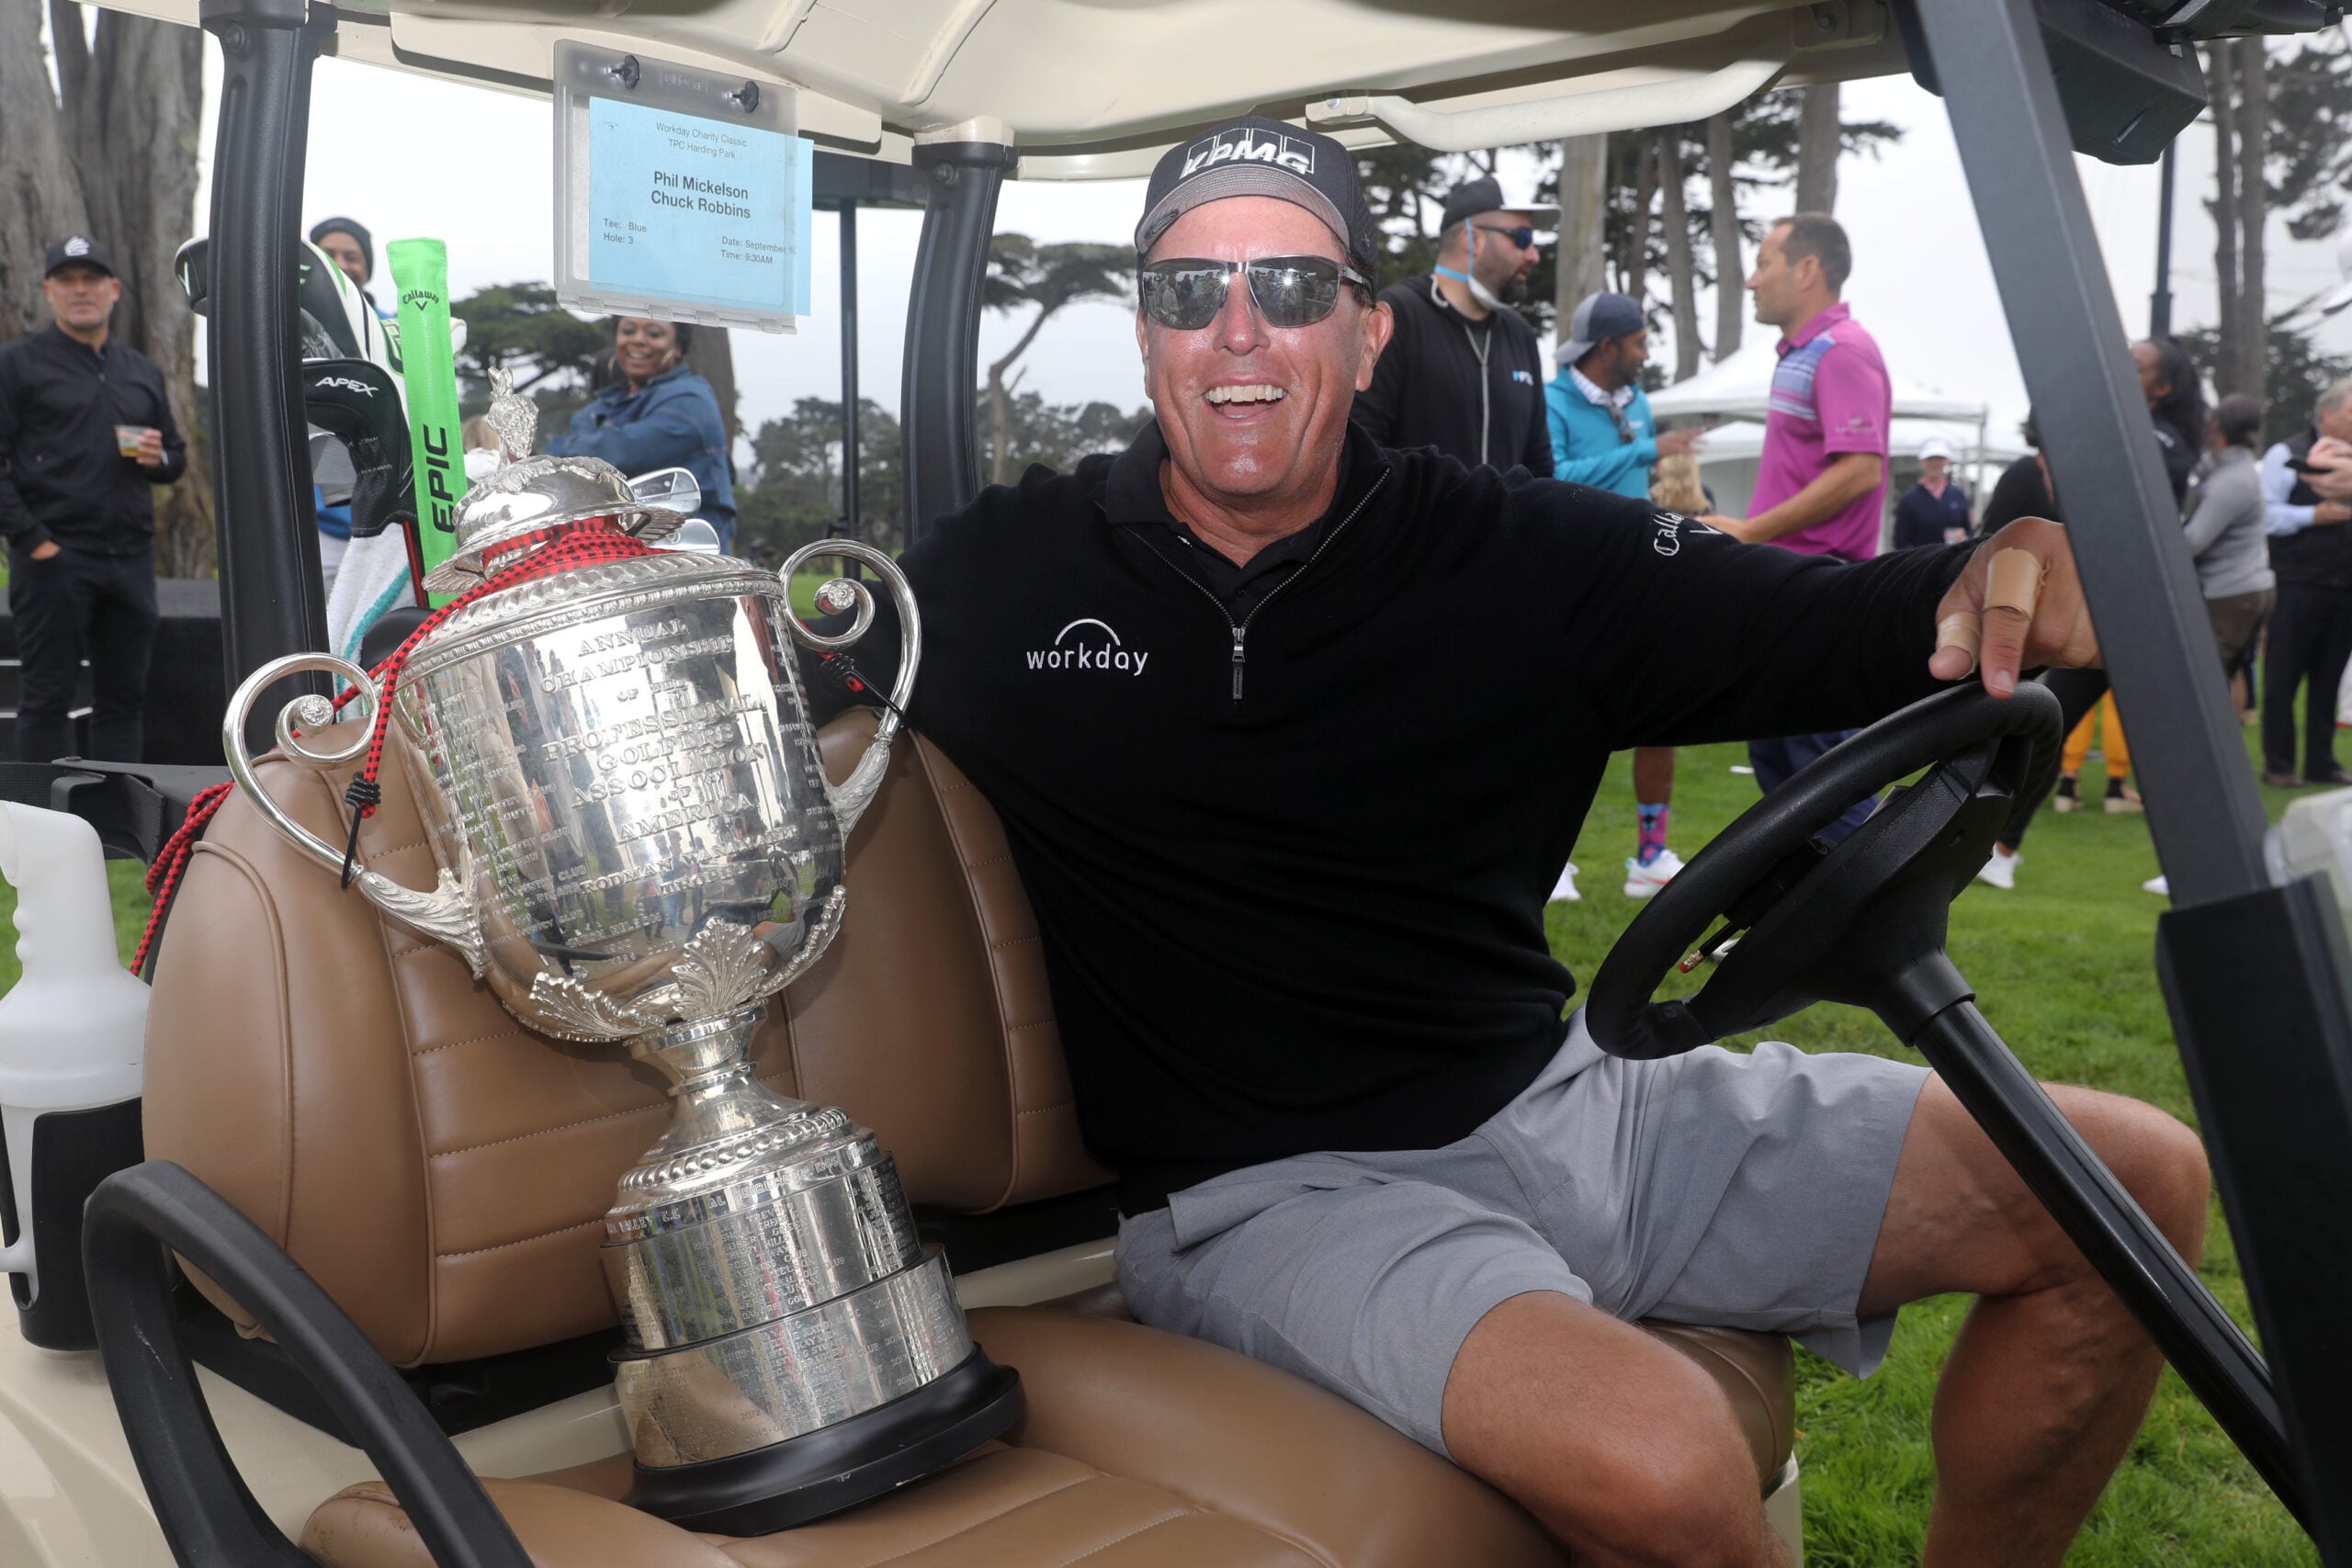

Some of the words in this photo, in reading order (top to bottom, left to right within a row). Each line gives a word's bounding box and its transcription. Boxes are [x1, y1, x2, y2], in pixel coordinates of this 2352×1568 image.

[657, 122, 690, 138] Workday
[692, 129, 718, 143] Charity
[721, 134, 747, 147] Classic
[669, 139, 685, 150] TPC
[687, 142, 718, 157] Harding
[719, 148, 735, 159] Park
[1179, 140, 1310, 179] KPMG
[654, 171, 678, 187] Phil
[683, 175, 748, 199] Mickelson
[651, 190, 694, 209] Chuck
[698, 197, 751, 219] Robbins
[604, 218, 621, 229] Tee:
[628, 222, 647, 232] Blue
[604, 232, 626, 243] Hole:
[628, 236, 634, 244] 3
[722, 236, 742, 246] Date:
[745, 240, 786, 253] September
[720, 249, 742, 260] Time:
[745, 253, 773, 265] 9:30AM
[402, 289, 439, 304] Callaway
[315, 377, 379, 398] APEX
[424, 423, 455, 533] EPIC
[579, 619, 689, 657] ANNUAL
[1026, 642, 1148, 676] workday
[616, 793, 754, 846] AMERICA
[558, 863, 587, 881] CLUB
[708, 1196, 726, 1209] AL
